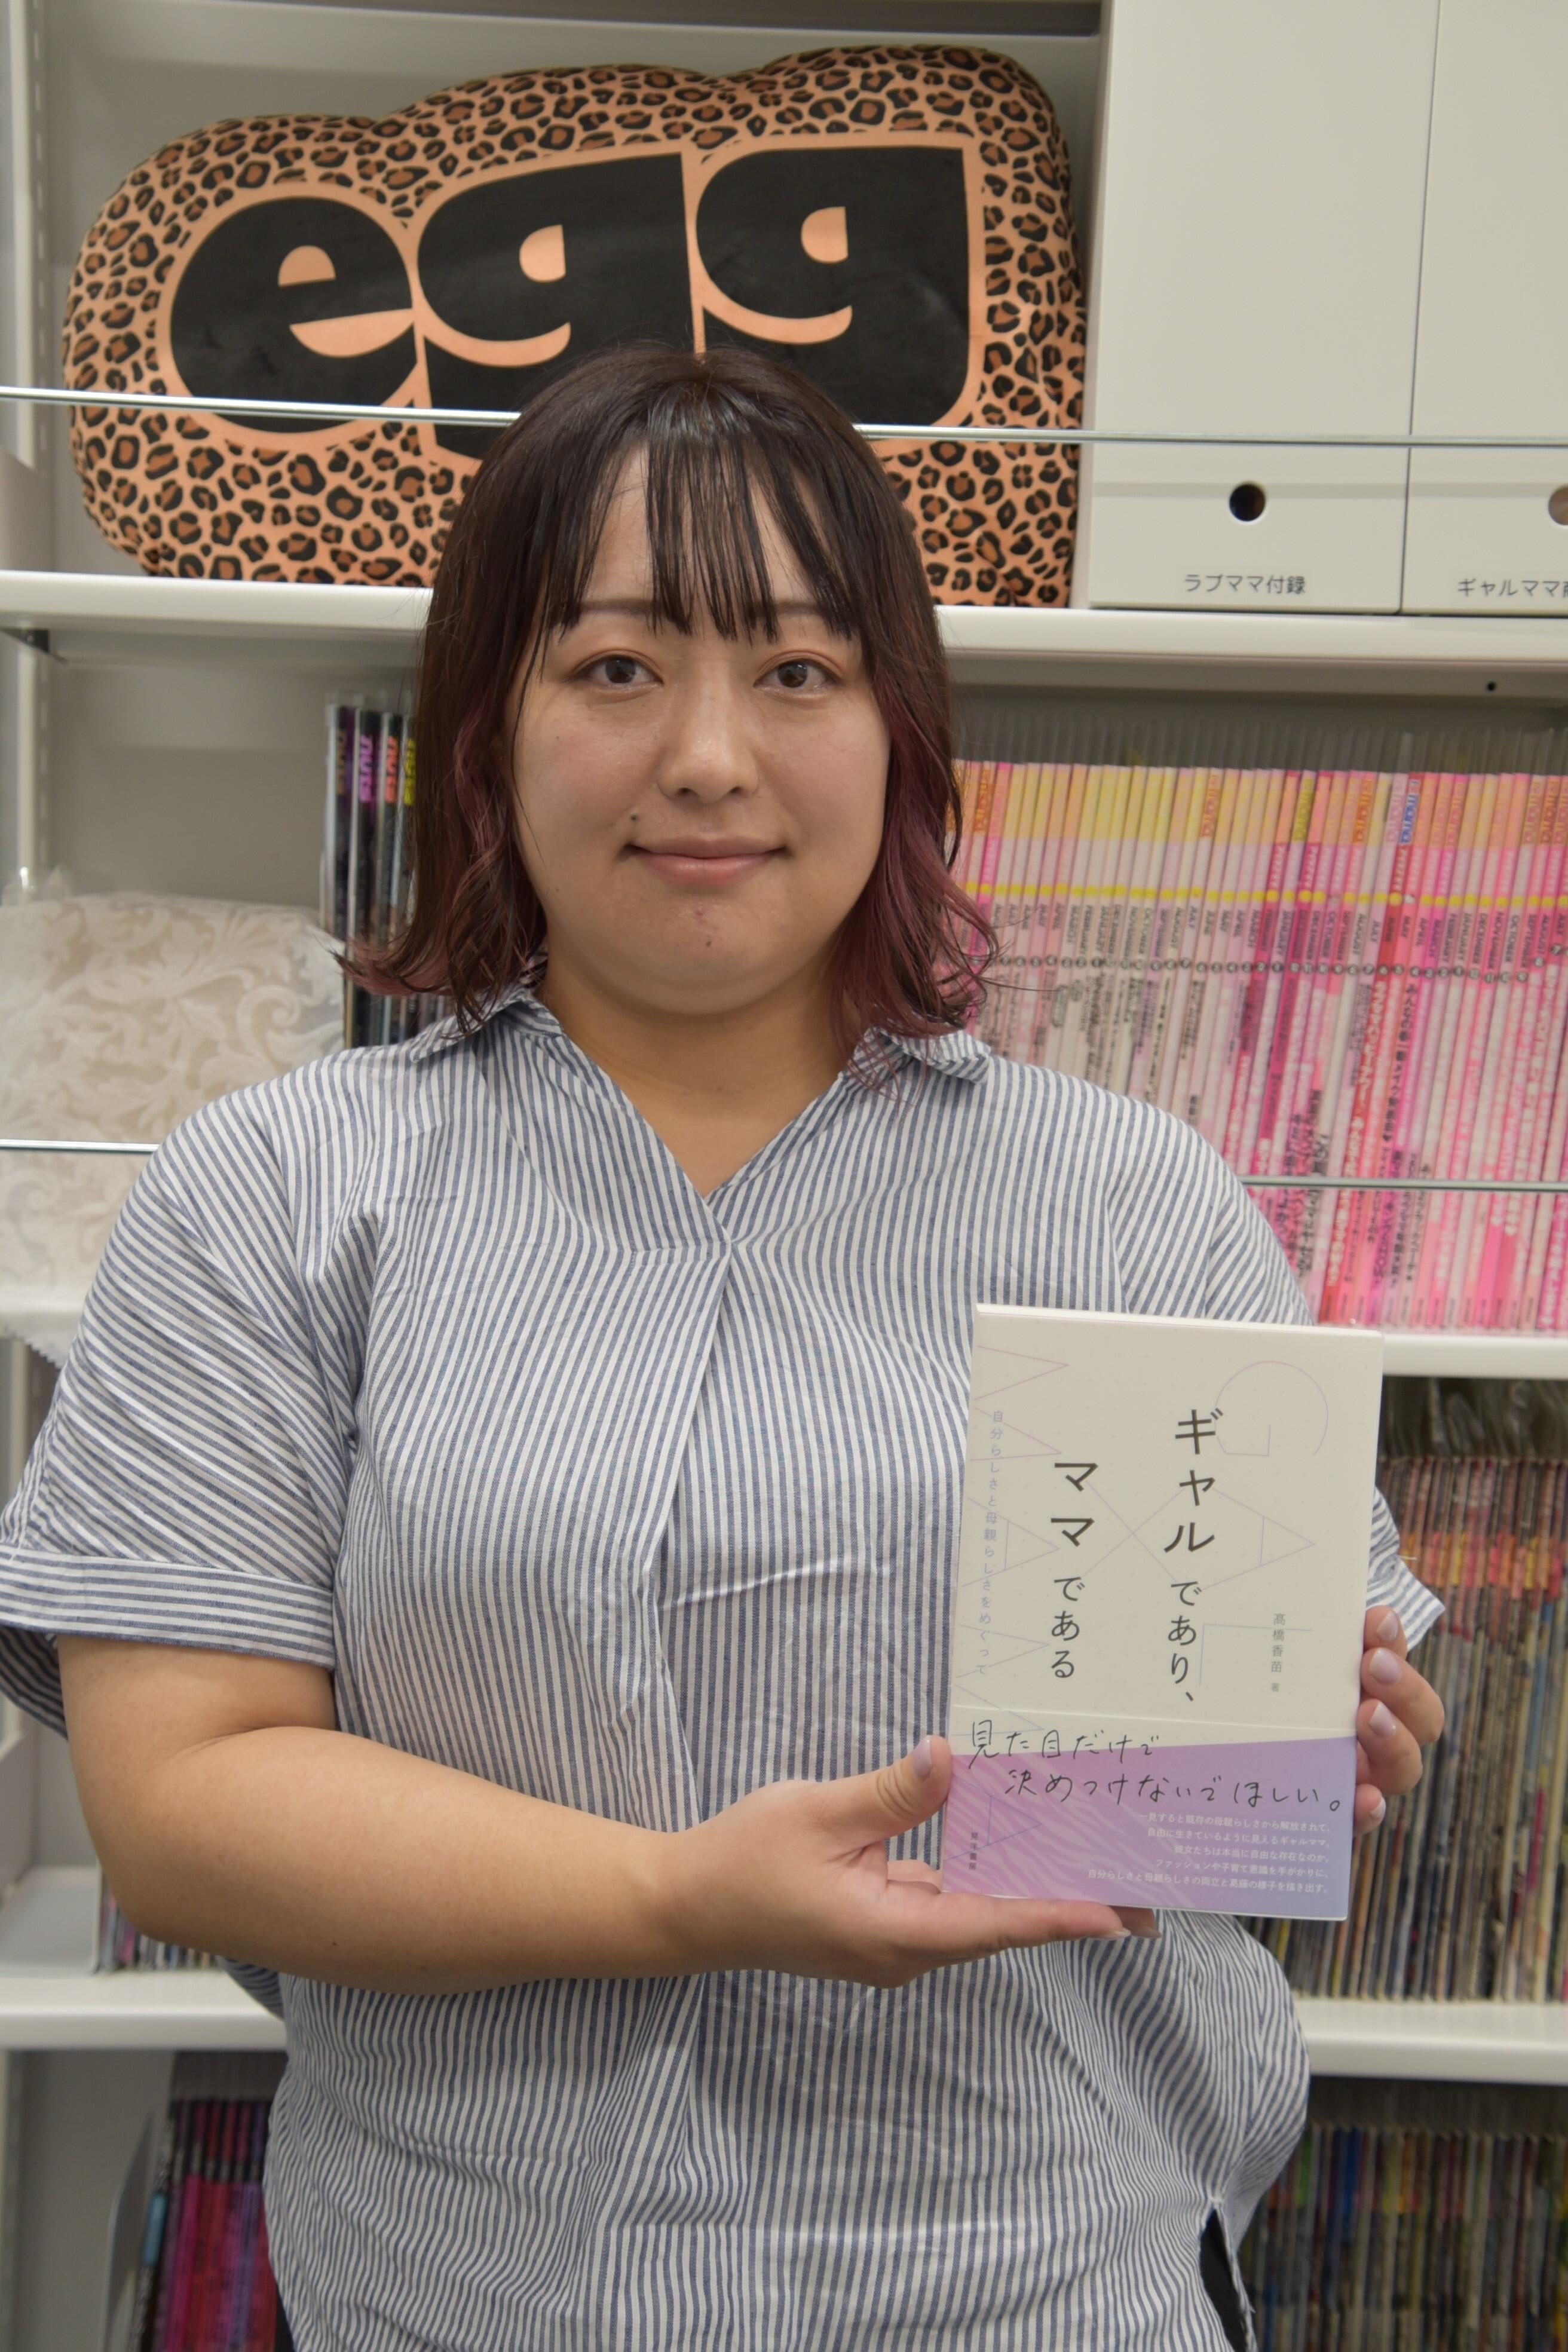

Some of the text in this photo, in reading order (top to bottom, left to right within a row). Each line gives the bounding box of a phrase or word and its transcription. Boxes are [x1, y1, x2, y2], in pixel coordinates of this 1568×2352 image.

[170, 145, 970, 458] egg
[1184, 574, 1306, 595] ラブママ付録
[1505, 915, 1519, 963] OCTOBER
[976, 1410, 1003, 1674] 自分らしさと母親らしさをめぐって
[1163, 1407, 1224, 1702] ギャルであり、
[1050, 1462, 1099, 1679] ママである
[968, 1719, 1159, 1769] 見た目だけで
[1004, 1769, 1341, 1811] 決めつけないでほしい。
[1138, 1811, 1331, 1833] 一見すると既存の母親らしさから解放されて、
[1147, 1827, 1330, 1848] 自由に生きているように見えるギャルママ。
[1156, 1859, 1329, 1878] ファッションや子育て意識を手がかりに、
[1174, 1845, 1330, 1863] 彼女たちは本当に自由な存在なのか。
